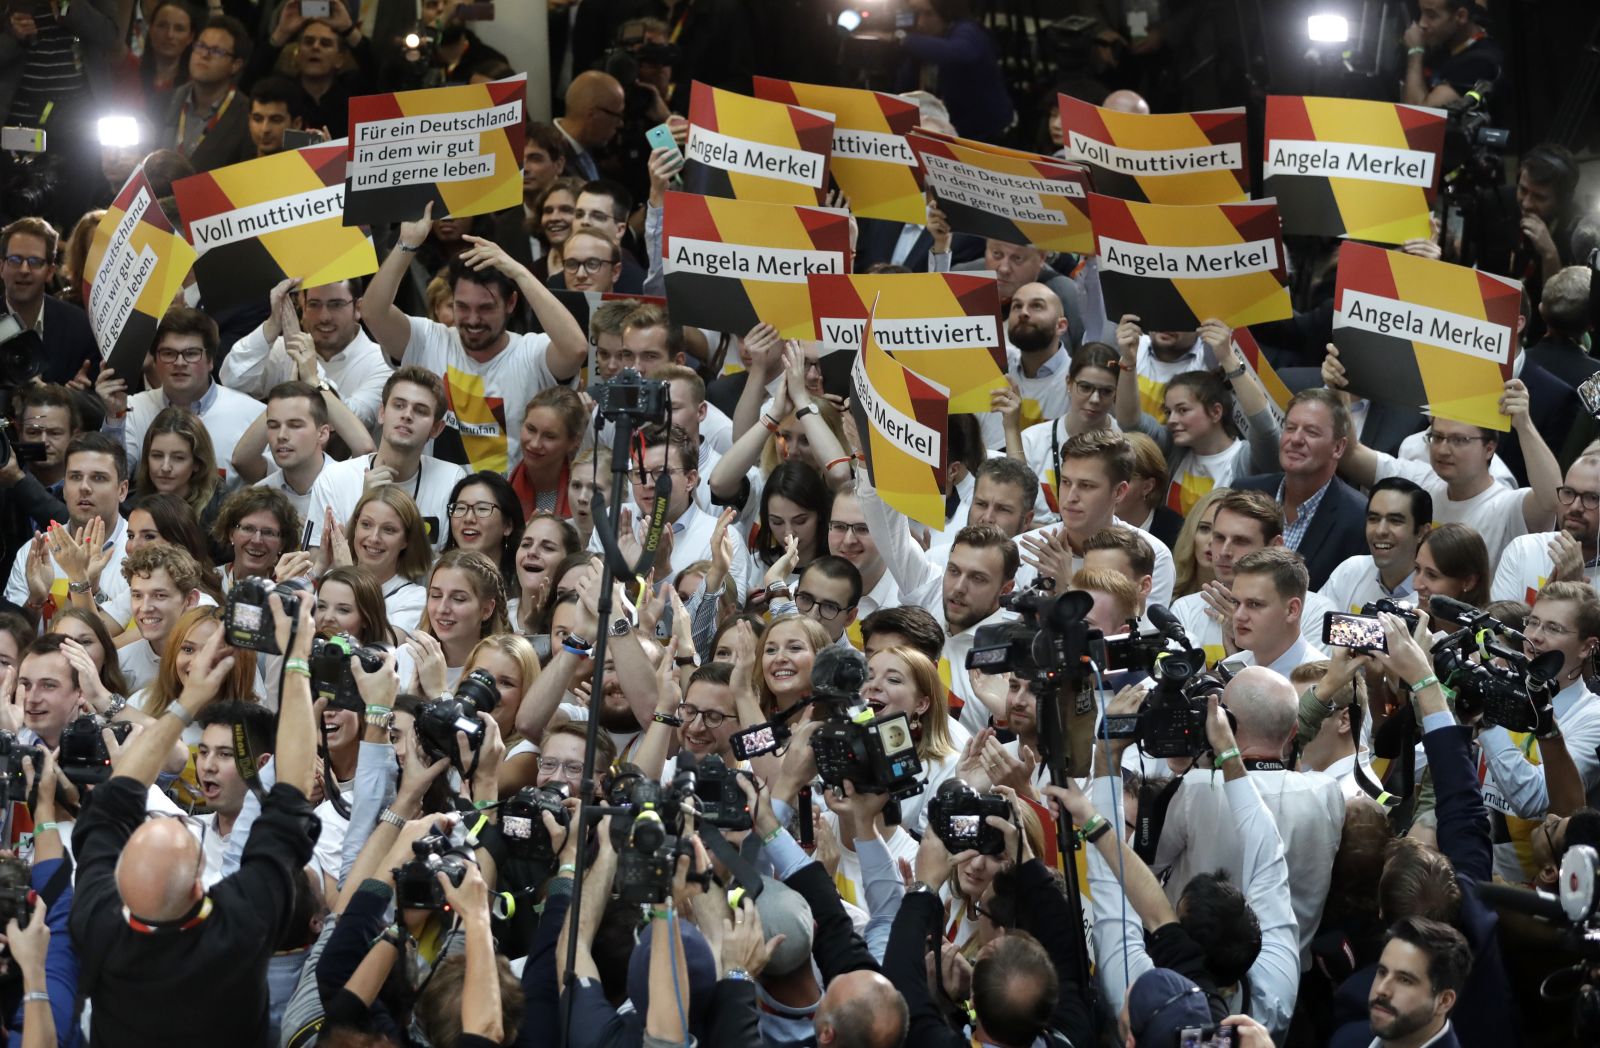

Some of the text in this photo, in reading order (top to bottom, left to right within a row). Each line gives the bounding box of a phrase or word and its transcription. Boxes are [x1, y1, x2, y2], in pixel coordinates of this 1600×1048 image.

[360, 106, 518, 141] Für ein Deutschland,
[359, 140, 475, 163] in dem wir gut
[690, 134, 817, 179] Angela Merkel
[831, 136, 913, 161] ttiviert.
[1074, 137, 1237, 172] Voll muttiviert.
[1273, 147, 1426, 179] Angela Merkel
[357, 159, 491, 186] und gerne leben.
[926, 156, 1081, 196] Für ein Deutschland,
[933, 170, 1037, 206] in dem wir gut
[940, 187, 1062, 222] und gerne leben.
[196, 214, 233, 244] Voll
[92, 197, 148, 308] ein Deutschland,
[676, 246, 835, 276] Angela Merkel
[1107, 246, 1269, 275] Angela Merkel
[96, 251, 135, 330] dem wir gut
[102, 256, 154, 357] nd gerne leben.
[874, 323, 992, 345] muttiviert.
[1347, 299, 1504, 355] Angela Merkel
[855, 356, 932, 457] ngela Merkel
[653, 496, 667, 526] Nikon
[1140, 817, 1149, 846] Canon
